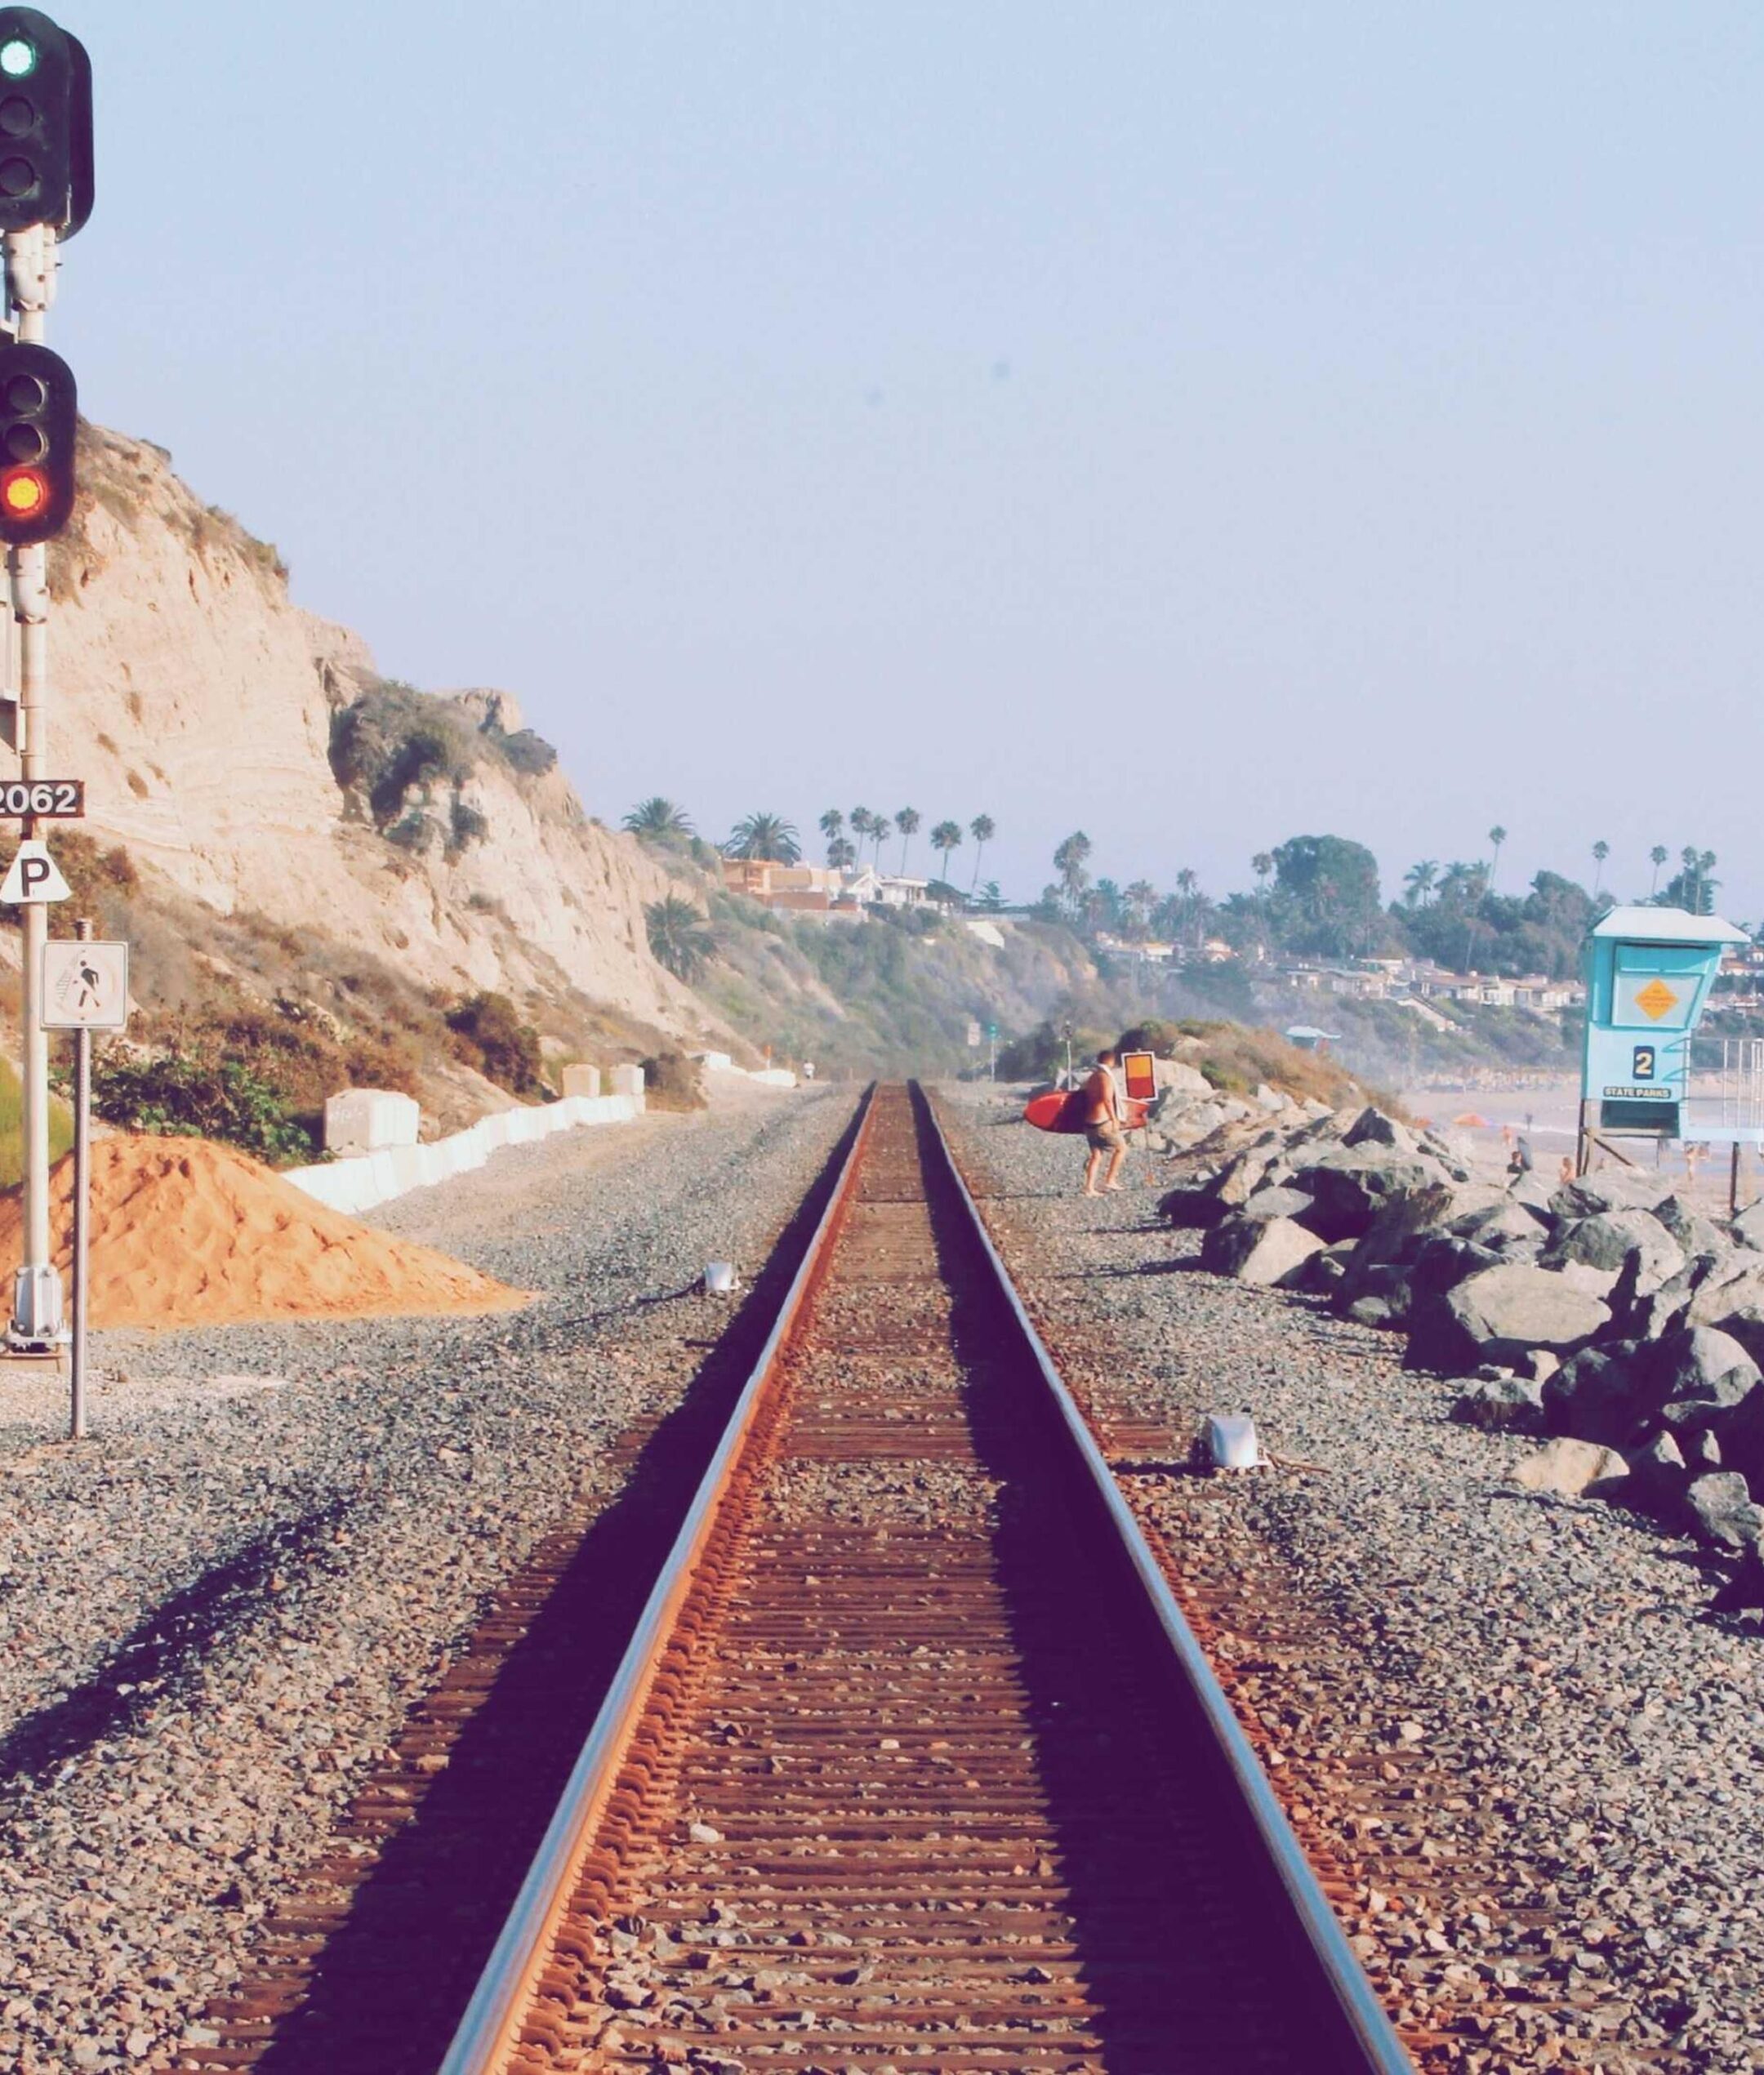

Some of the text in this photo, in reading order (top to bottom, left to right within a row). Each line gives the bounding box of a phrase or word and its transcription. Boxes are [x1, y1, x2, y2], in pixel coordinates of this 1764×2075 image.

[0, 783, 77, 814] 062
[21, 857, 50, 897] P
[1635, 1052, 1653, 1075] 2
[1606, 1087, 1669, 1098] STATE PARKS
